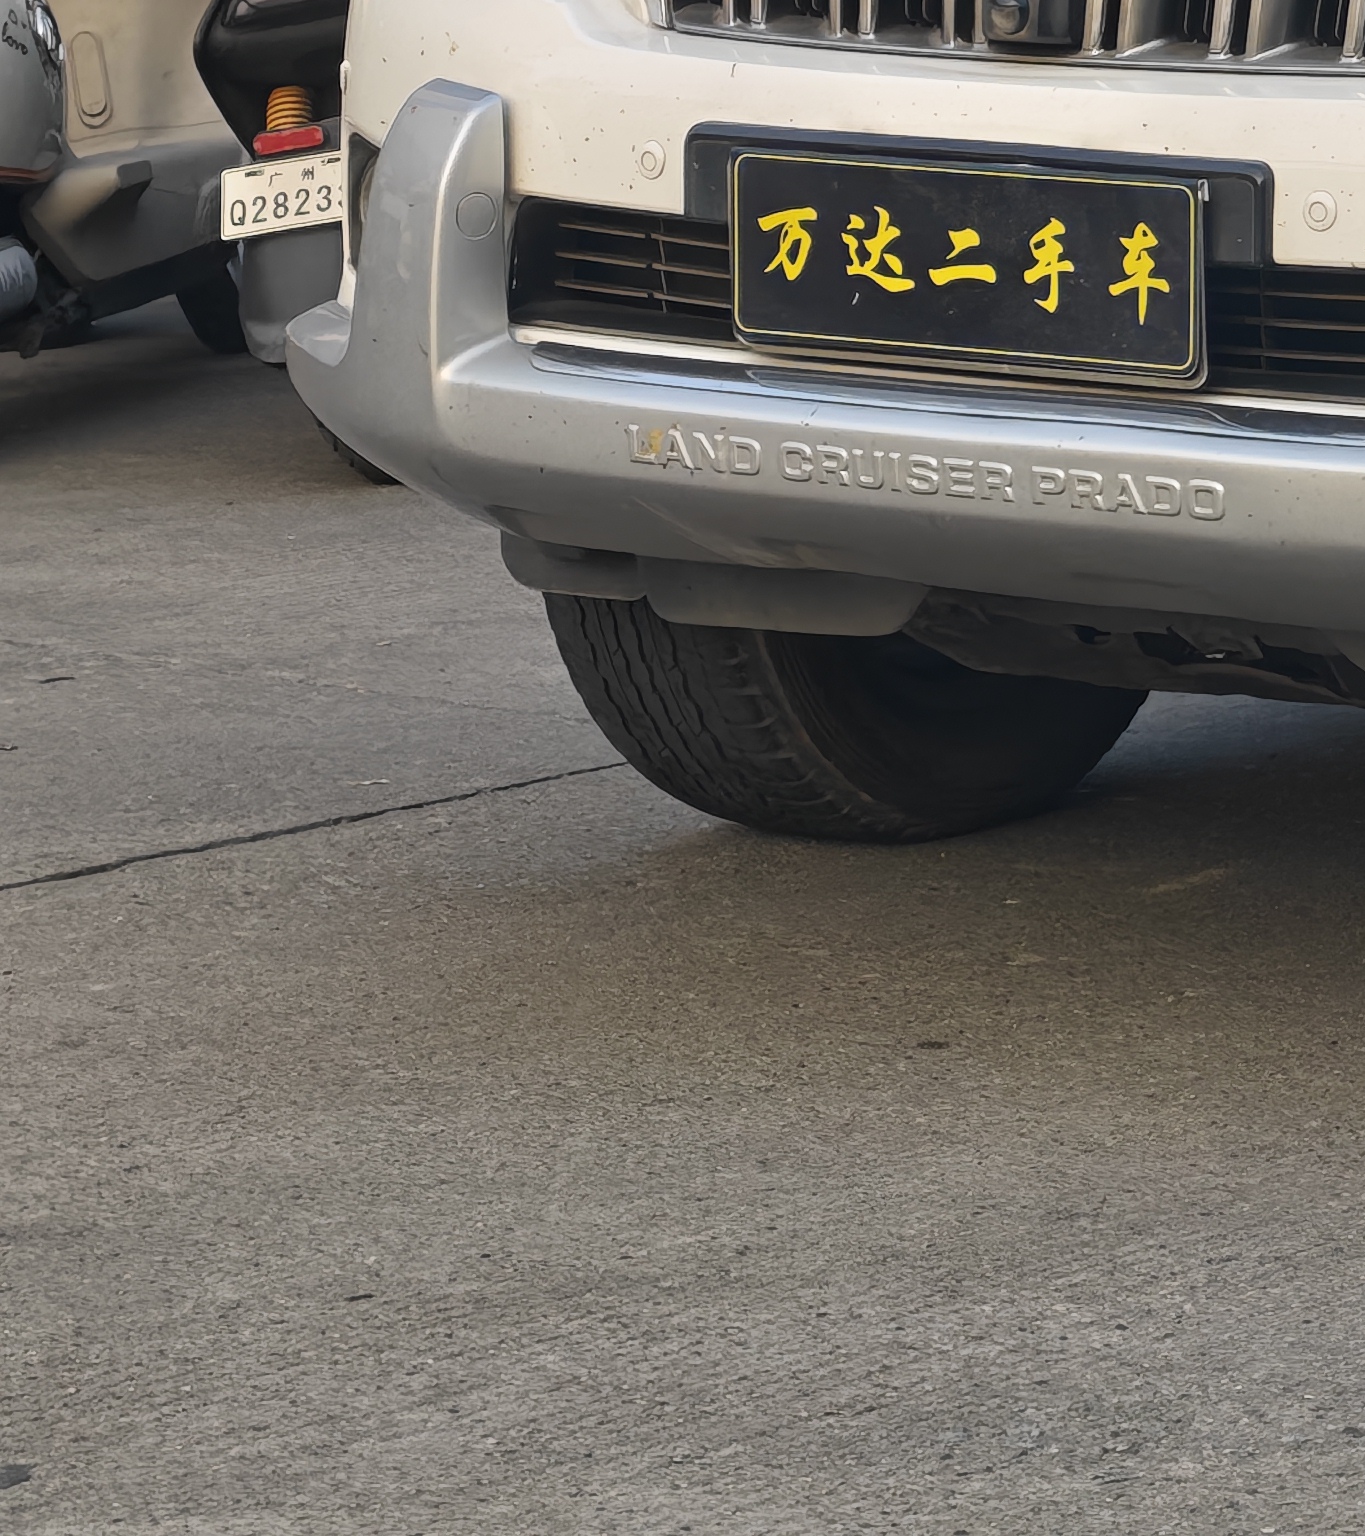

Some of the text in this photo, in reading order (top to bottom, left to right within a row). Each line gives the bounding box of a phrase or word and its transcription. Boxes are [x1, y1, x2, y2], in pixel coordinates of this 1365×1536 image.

[230, 184, 343, 226] Q2823
[757, 205, 1171, 326] 万达二手车
[624, 422, 1226, 521] LAND CRUISER PRADO
